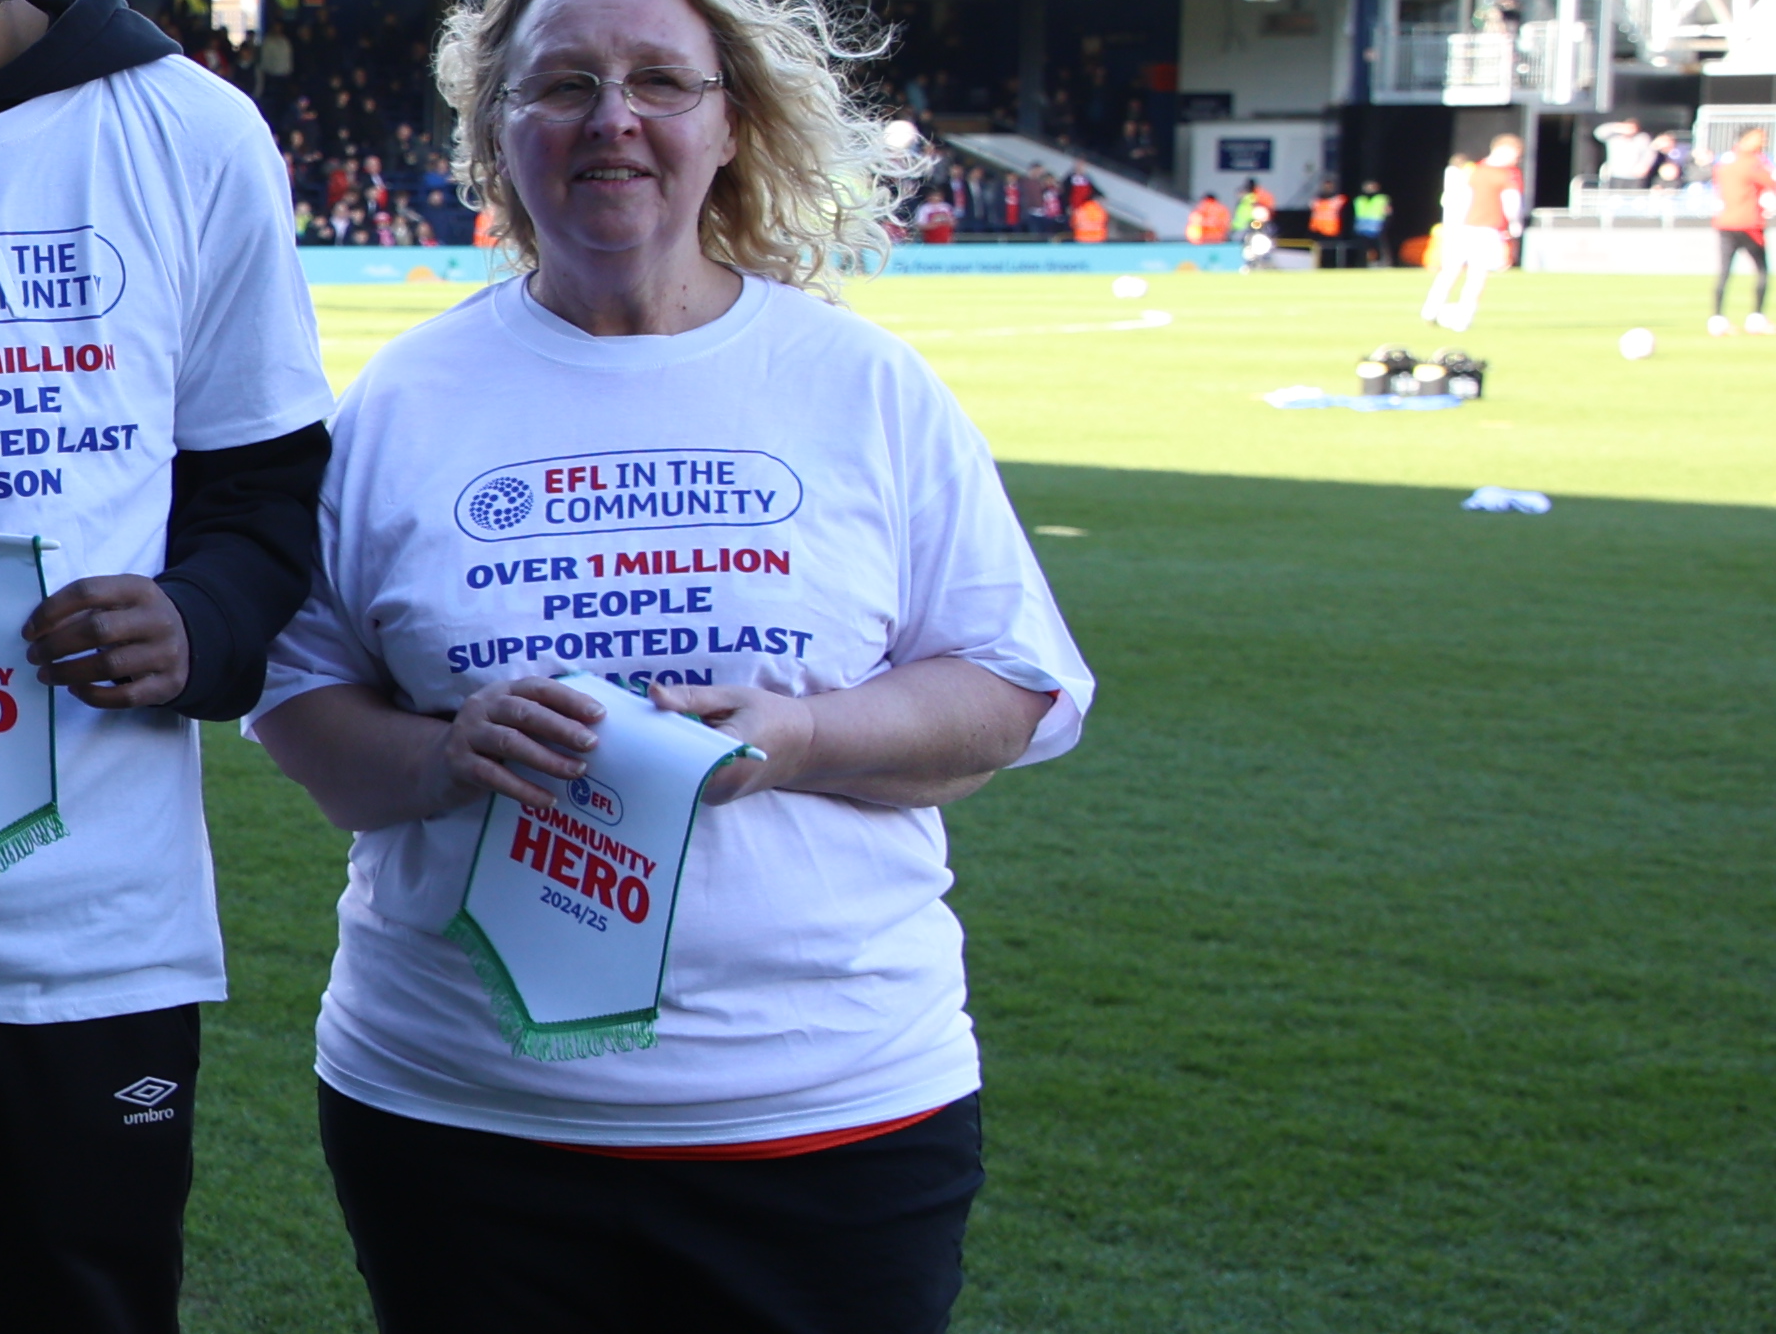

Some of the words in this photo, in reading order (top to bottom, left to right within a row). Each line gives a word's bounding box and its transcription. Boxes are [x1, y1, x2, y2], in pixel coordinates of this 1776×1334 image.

[11, 243, 76, 275] THE
[57, 424, 138, 454] LAST
[545, 465, 607, 494] EFL
[616, 462, 656, 489] IN
[667, 460, 735, 487] THE
[546, 490, 776, 524] COMMUNITY
[466, 556, 577, 589] OVER
[587, 554, 604, 578] 1
[615, 548, 790, 577] MILLION
[543, 586, 712, 621] PEOPLE
[447, 627, 699, 674] SUPPORTED
[708, 626, 813, 660] LAST
[590, 792, 615, 816] EFL
[509, 816, 650, 925] HERO
[540, 886, 609, 932] 2024/25
[124, 1106, 175, 1127] umbro
